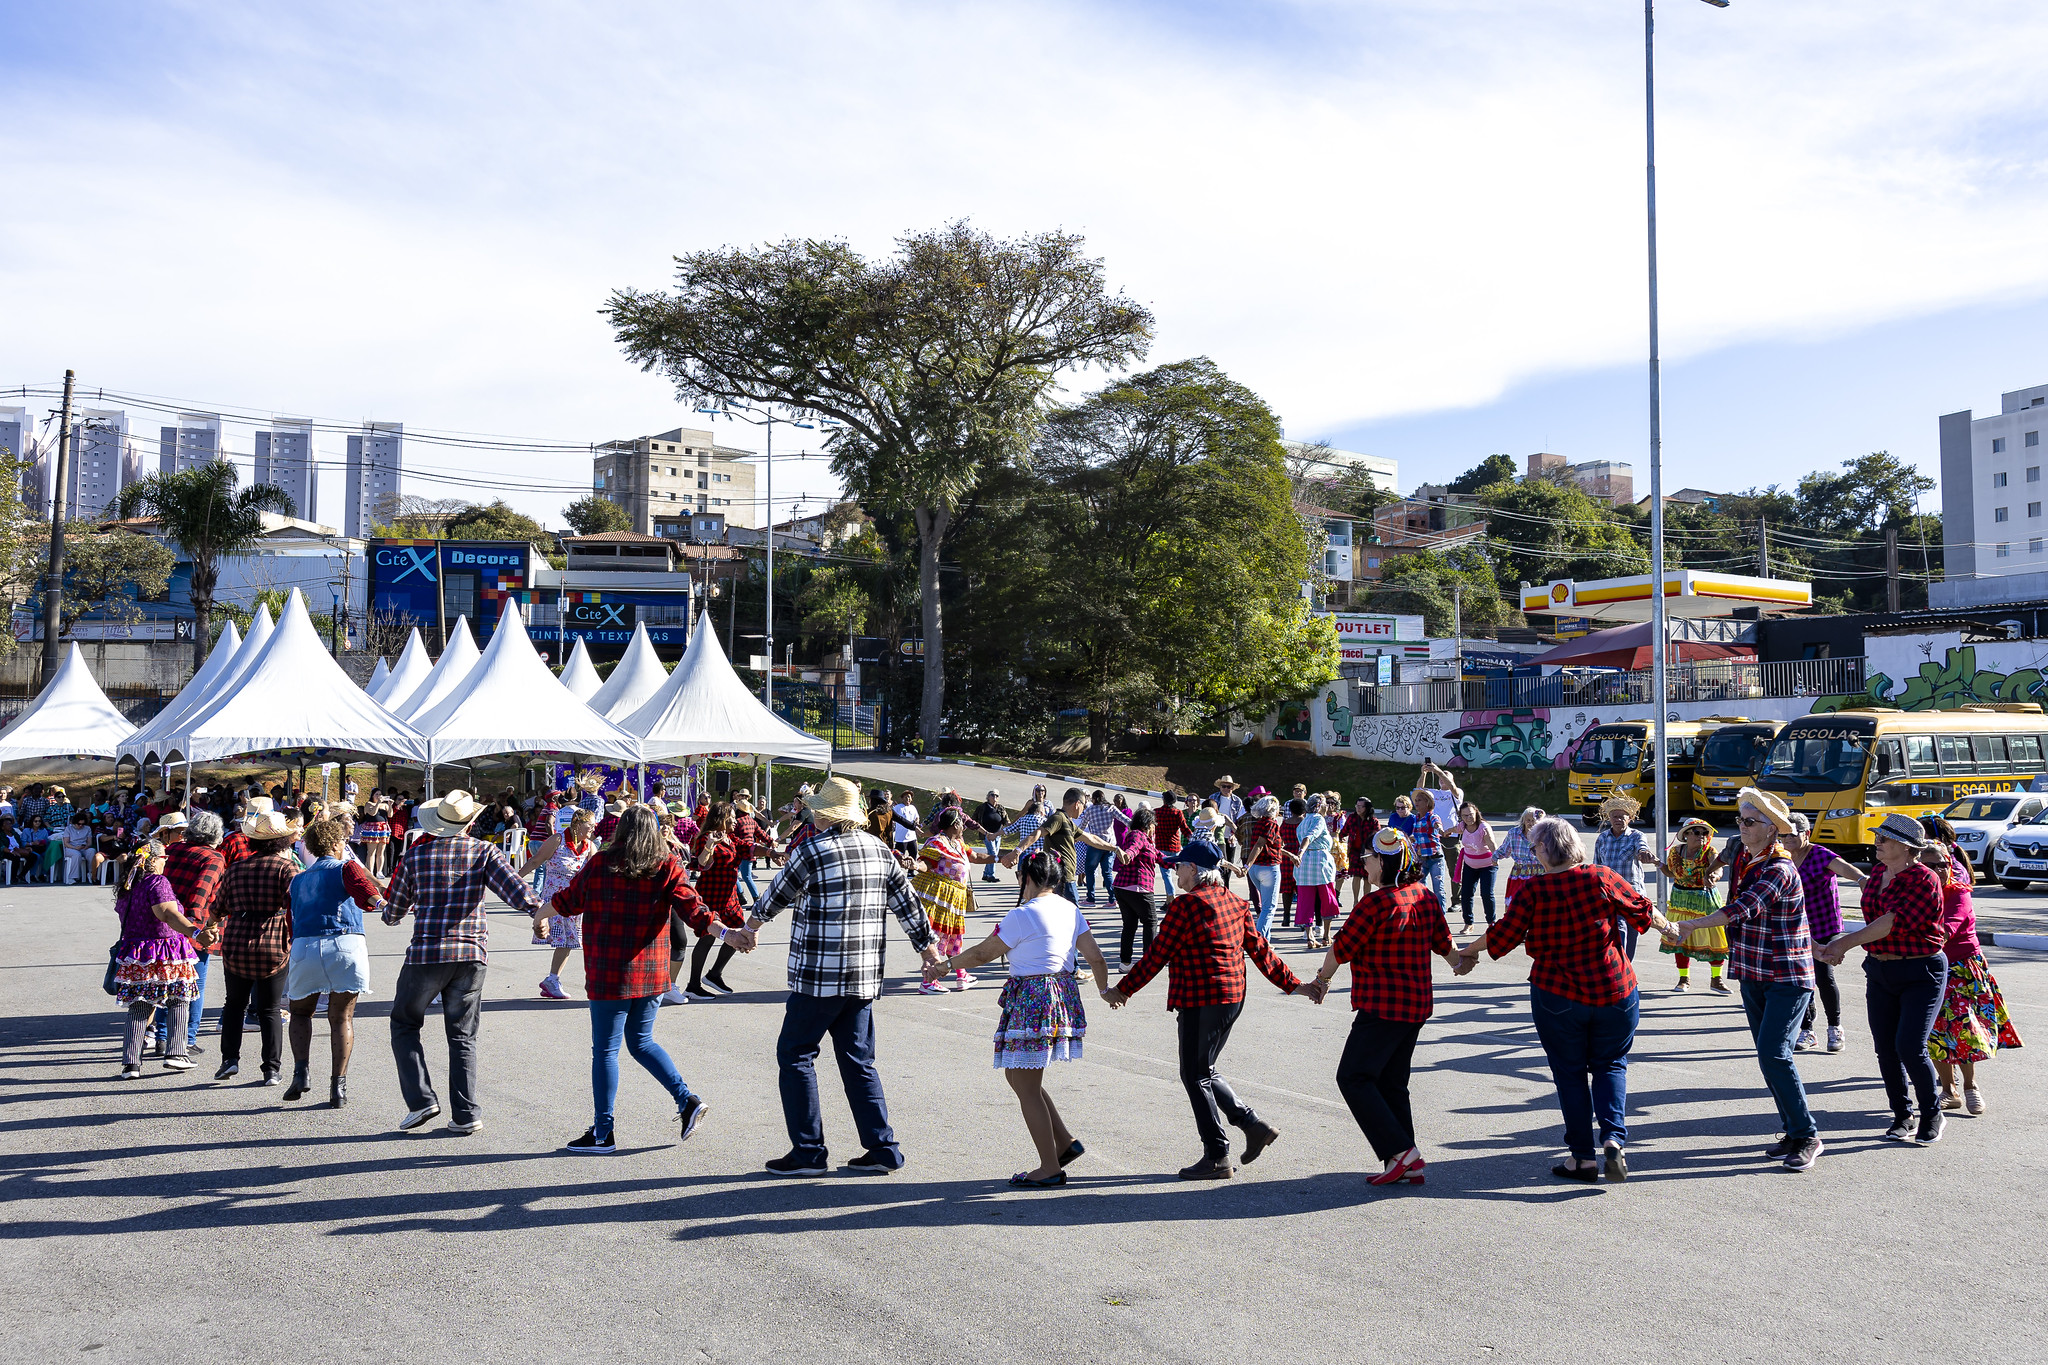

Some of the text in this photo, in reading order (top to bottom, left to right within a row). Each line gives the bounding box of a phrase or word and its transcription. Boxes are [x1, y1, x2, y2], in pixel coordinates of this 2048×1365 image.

[451, 550, 520, 565] Decora
[1334, 622, 1391, 634] OUTLET
[529, 630, 669, 641] TINTAS & TEXTAS
[1476, 658, 1513, 667] PRIMAX
[1788, 728, 1860, 740] ESCOLAR
[1953, 782, 2012, 800] ESCOLAR
